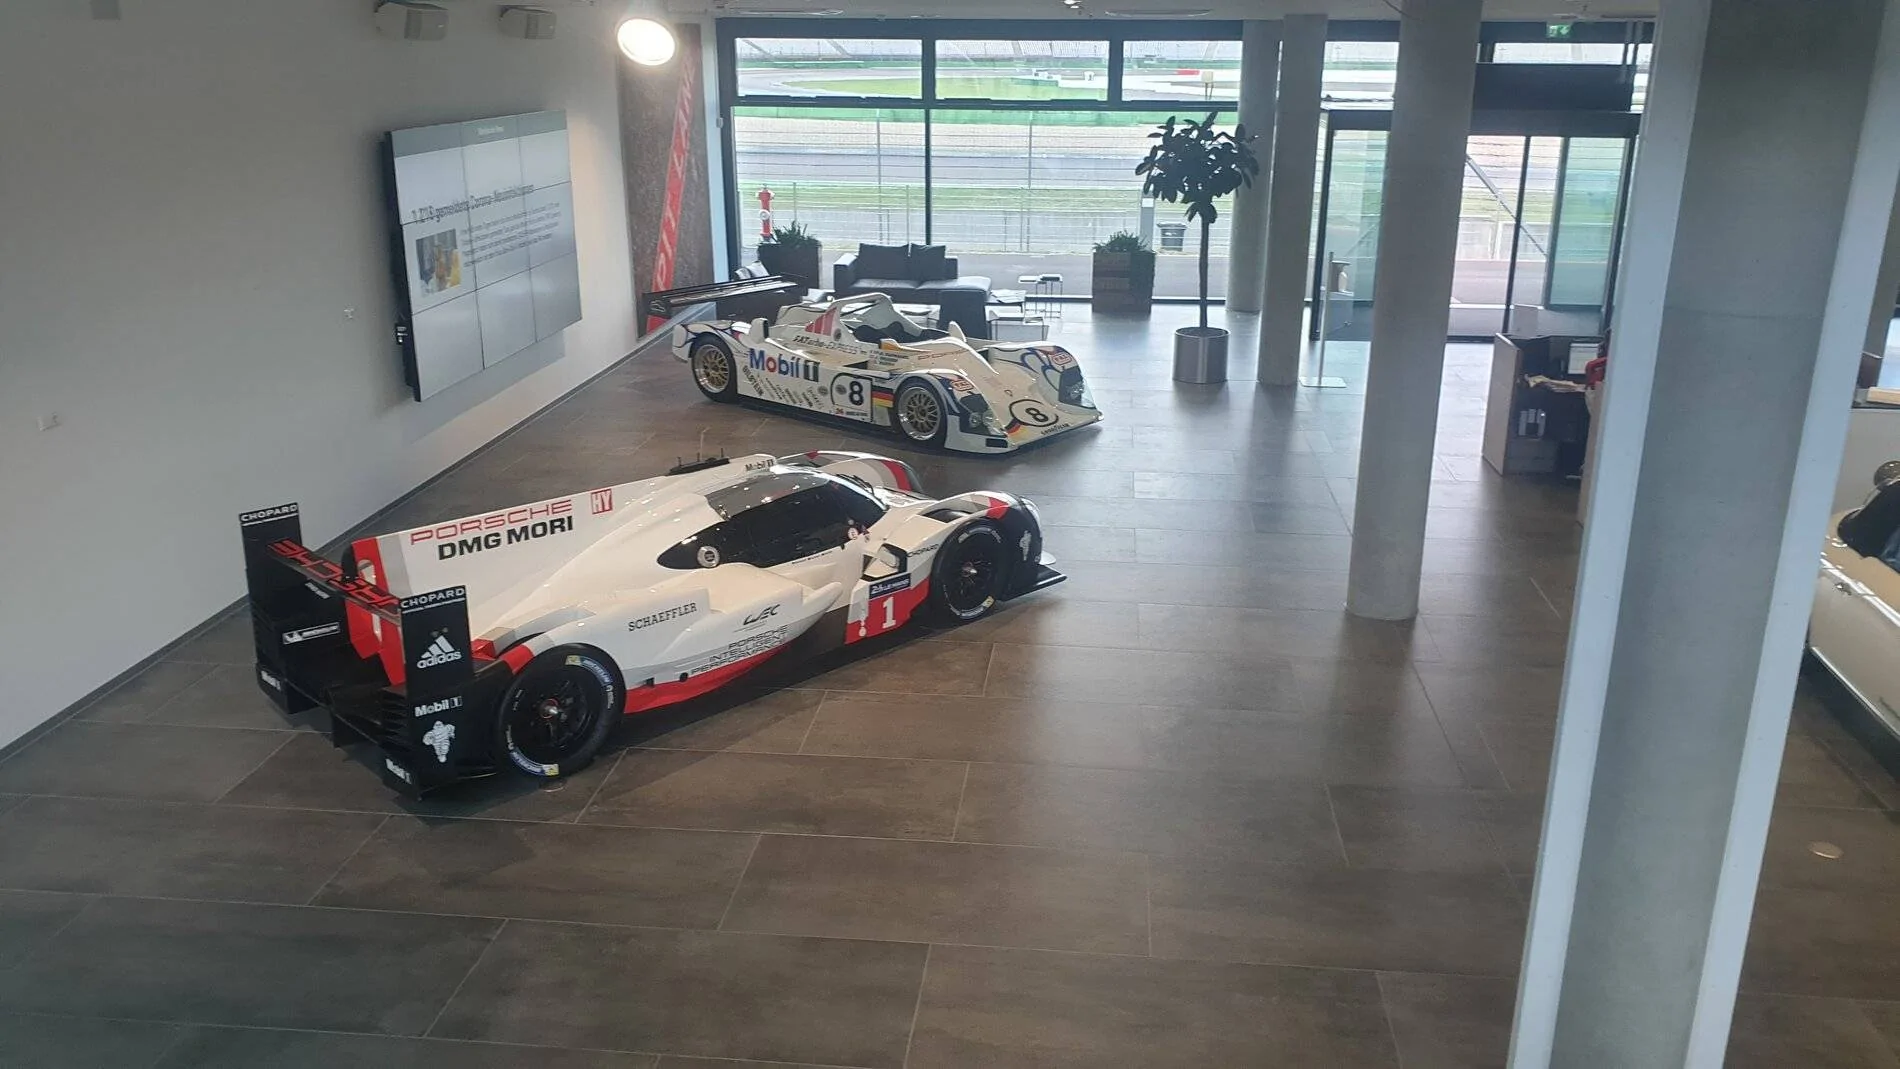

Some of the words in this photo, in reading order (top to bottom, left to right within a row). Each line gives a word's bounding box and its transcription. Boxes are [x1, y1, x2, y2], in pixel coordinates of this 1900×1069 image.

[750, 348, 800, 379] Mobil
[848, 381, 864, 406] 8
[1025, 407, 1049, 423] 8
[240, 504, 298, 523] CHOPARD
[591, 489, 613, 515] HY
[410, 499, 572, 545] PORSCHE
[437, 532, 501, 561] DMG
[507, 515, 573, 545] MORI
[400, 587, 465, 609] CHOPARD
[628, 602, 698, 632] SCHAEFFLER
[742, 604, 781, 626] WEC
[882, 596, 897, 629] 1
[708, 633, 788, 662] INTELLIGENT
[728, 625, 788, 649] PORSCHE
[416, 650, 462, 669] adidas
[414, 699, 450, 717] Mobil
[450, 696, 462, 709] 1
